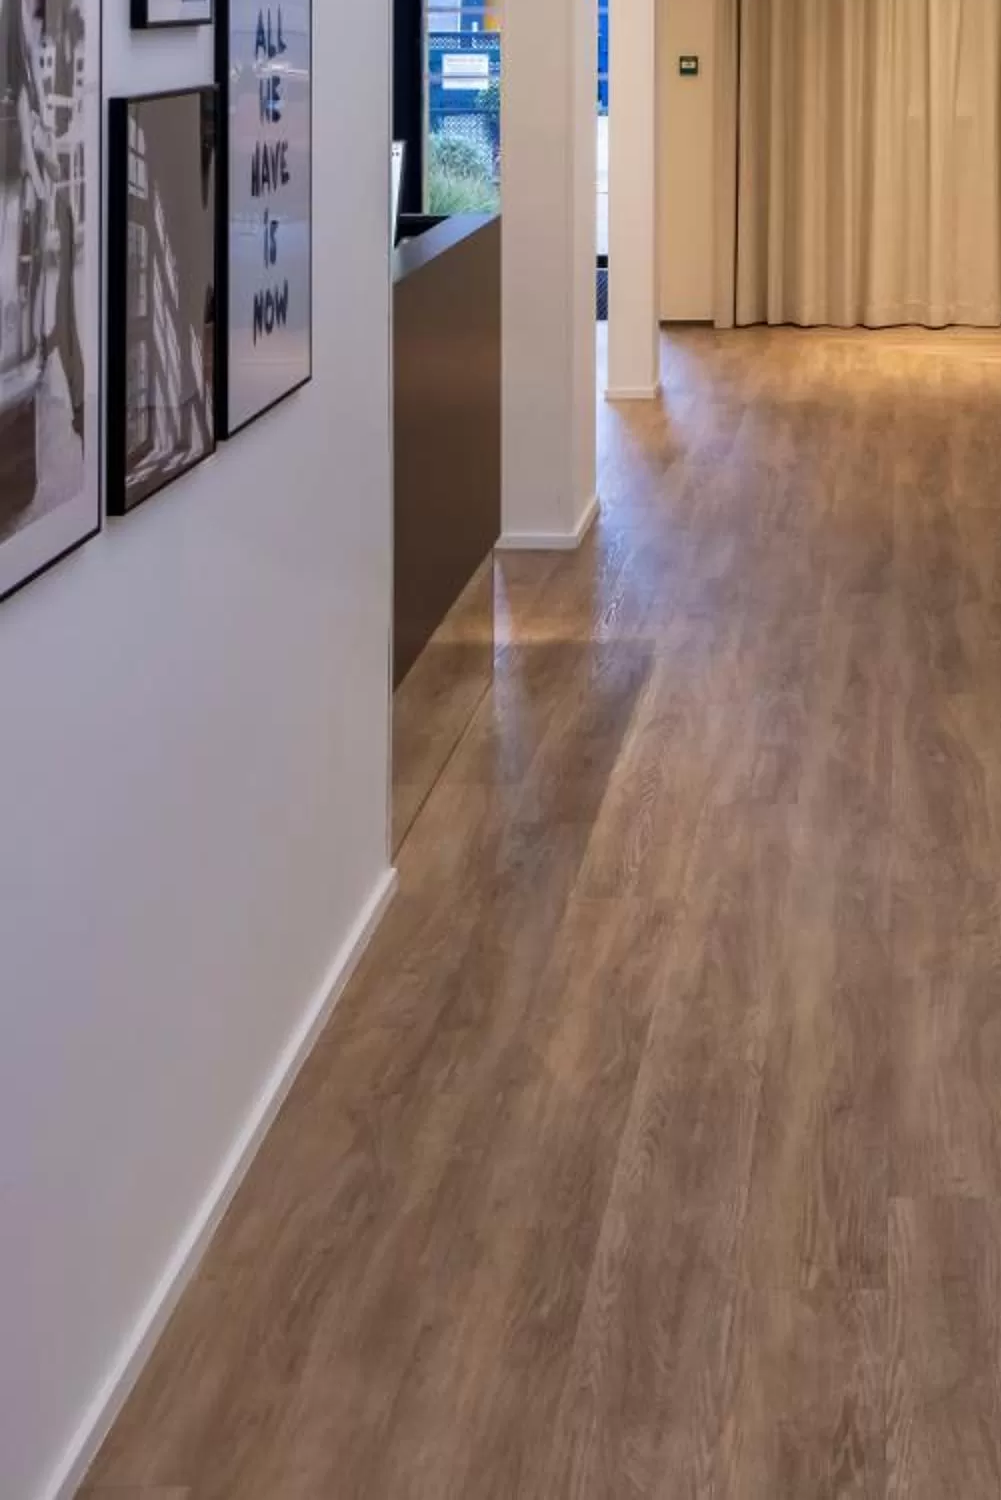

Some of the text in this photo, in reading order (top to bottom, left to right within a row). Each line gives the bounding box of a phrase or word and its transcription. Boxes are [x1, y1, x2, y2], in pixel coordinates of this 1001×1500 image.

[255, 4, 287, 60] ALL
[251, 139, 290, 197] HAVE
[253, 277, 288, 347] NOW
